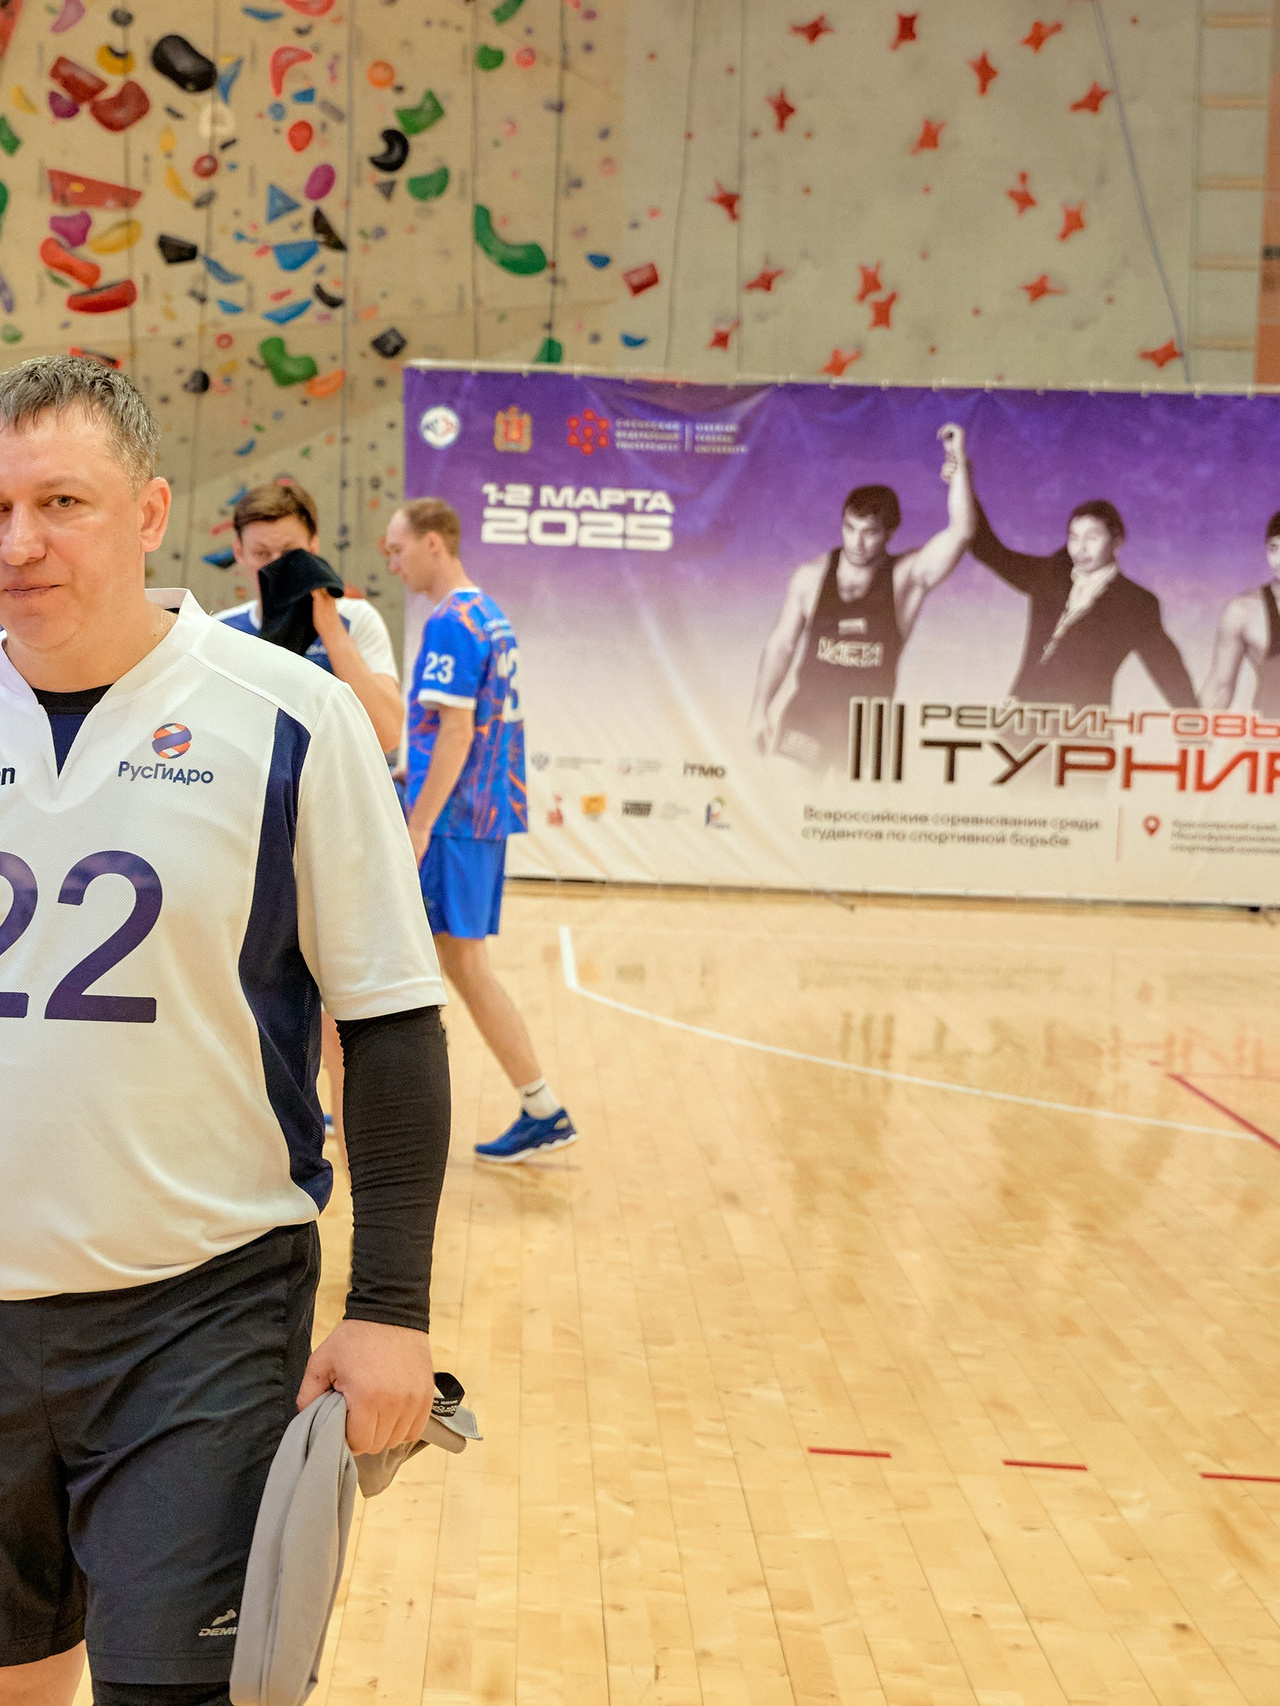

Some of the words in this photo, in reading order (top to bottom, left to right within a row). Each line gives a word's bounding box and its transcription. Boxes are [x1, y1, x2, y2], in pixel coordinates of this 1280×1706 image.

[481, 483, 533, 506] 1-2
[539, 485, 675, 513] МАРТА
[481, 506, 673, 551] 2025
[422, 651, 455, 684] 23
[851, 702, 905, 782] III
[118, 760, 214, 786] РусГидро
[803, 804, 929, 824] Всероссийские
[198, 1626, 238, 1637] DEMI
